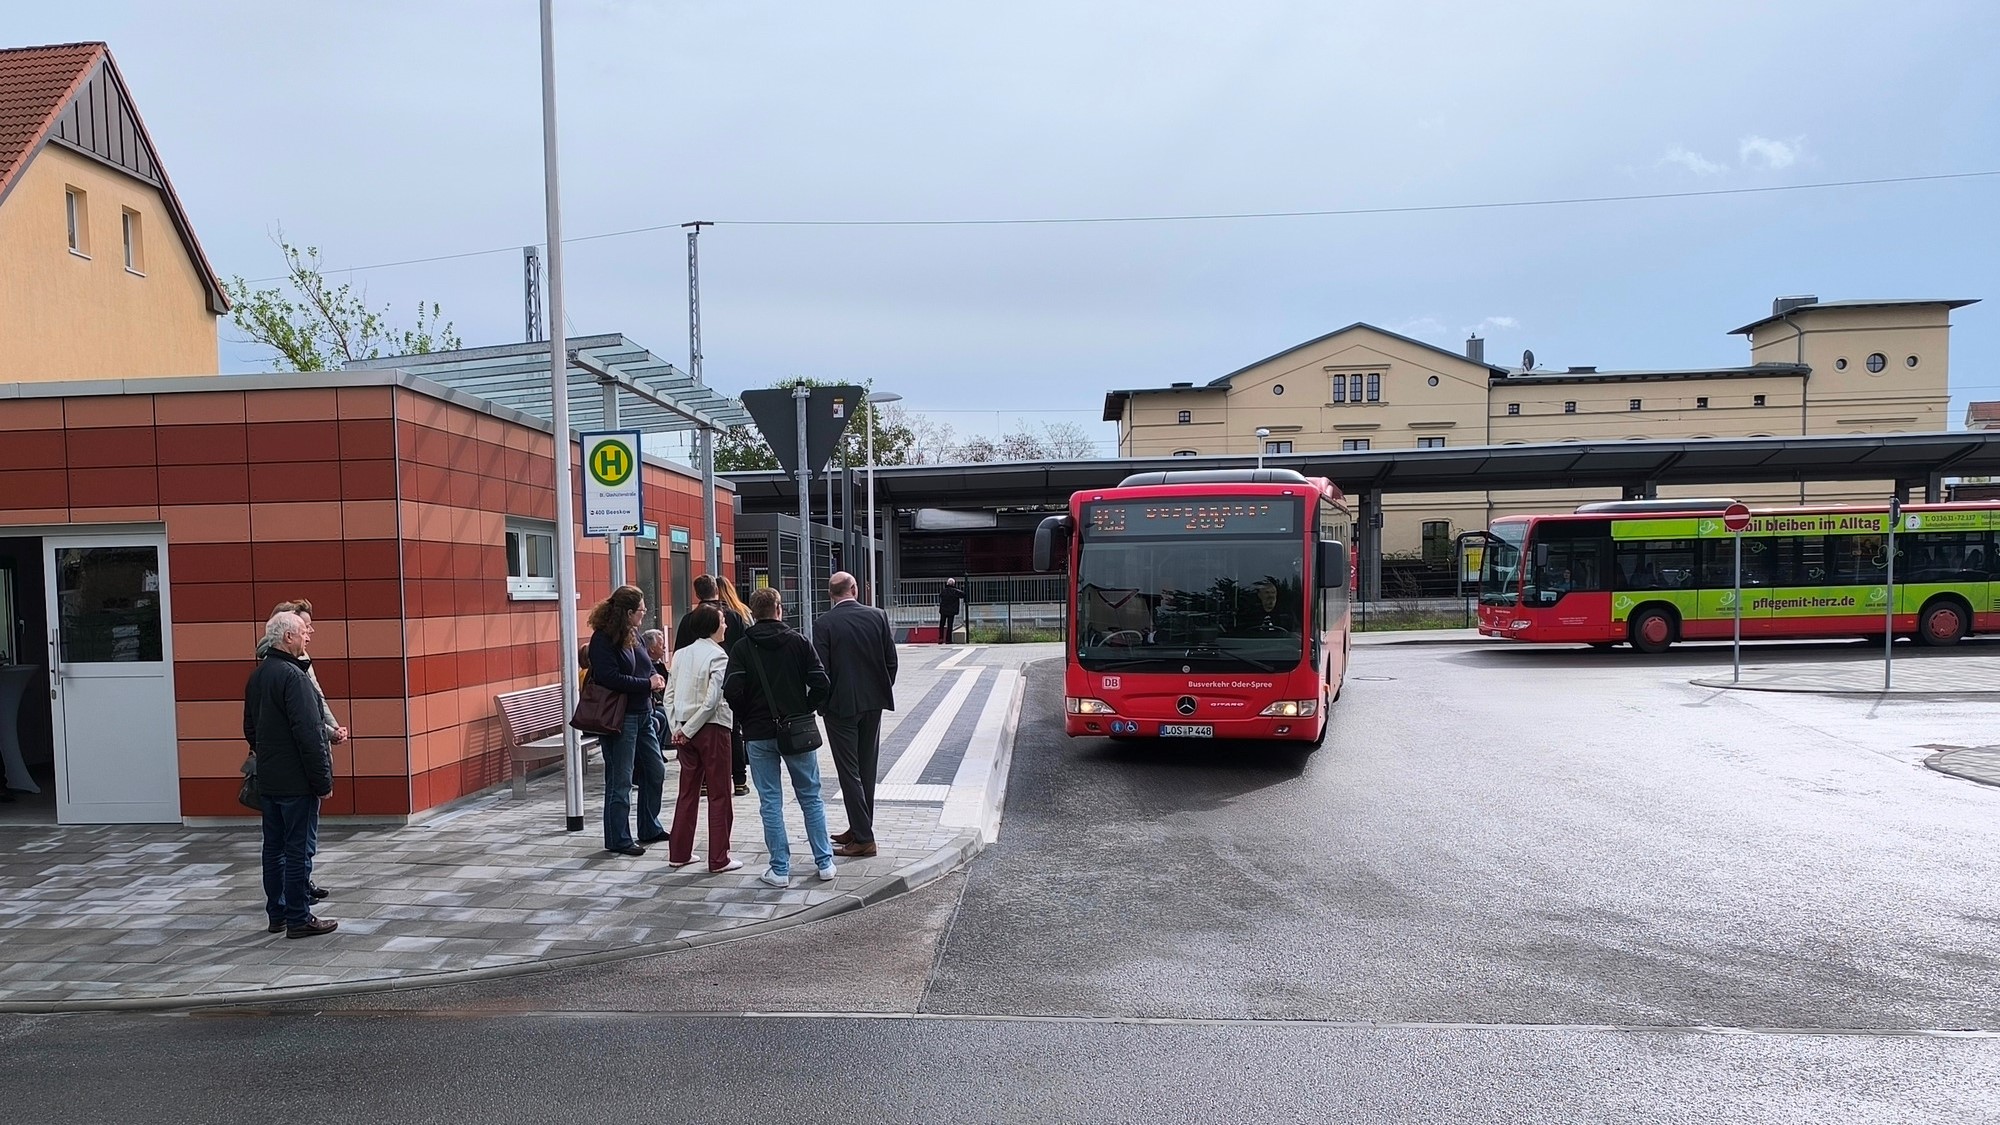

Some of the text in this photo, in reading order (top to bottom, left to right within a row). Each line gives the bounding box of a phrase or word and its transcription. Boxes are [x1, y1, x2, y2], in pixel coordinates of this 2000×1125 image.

[601, 450, 622, 475] H
[1765, 519, 1815, 532] bleiben
[1819, 518, 1835, 530] im
[1839, 518, 1881, 531] Alltag
[1752, 596, 1855, 610] pflegemit-herz.de
[1105, 679, 1118, 687] DB
[1231, 681, 1273, 689] Oder-Spree
[1165, 726, 1212, 736] LOS P 448
